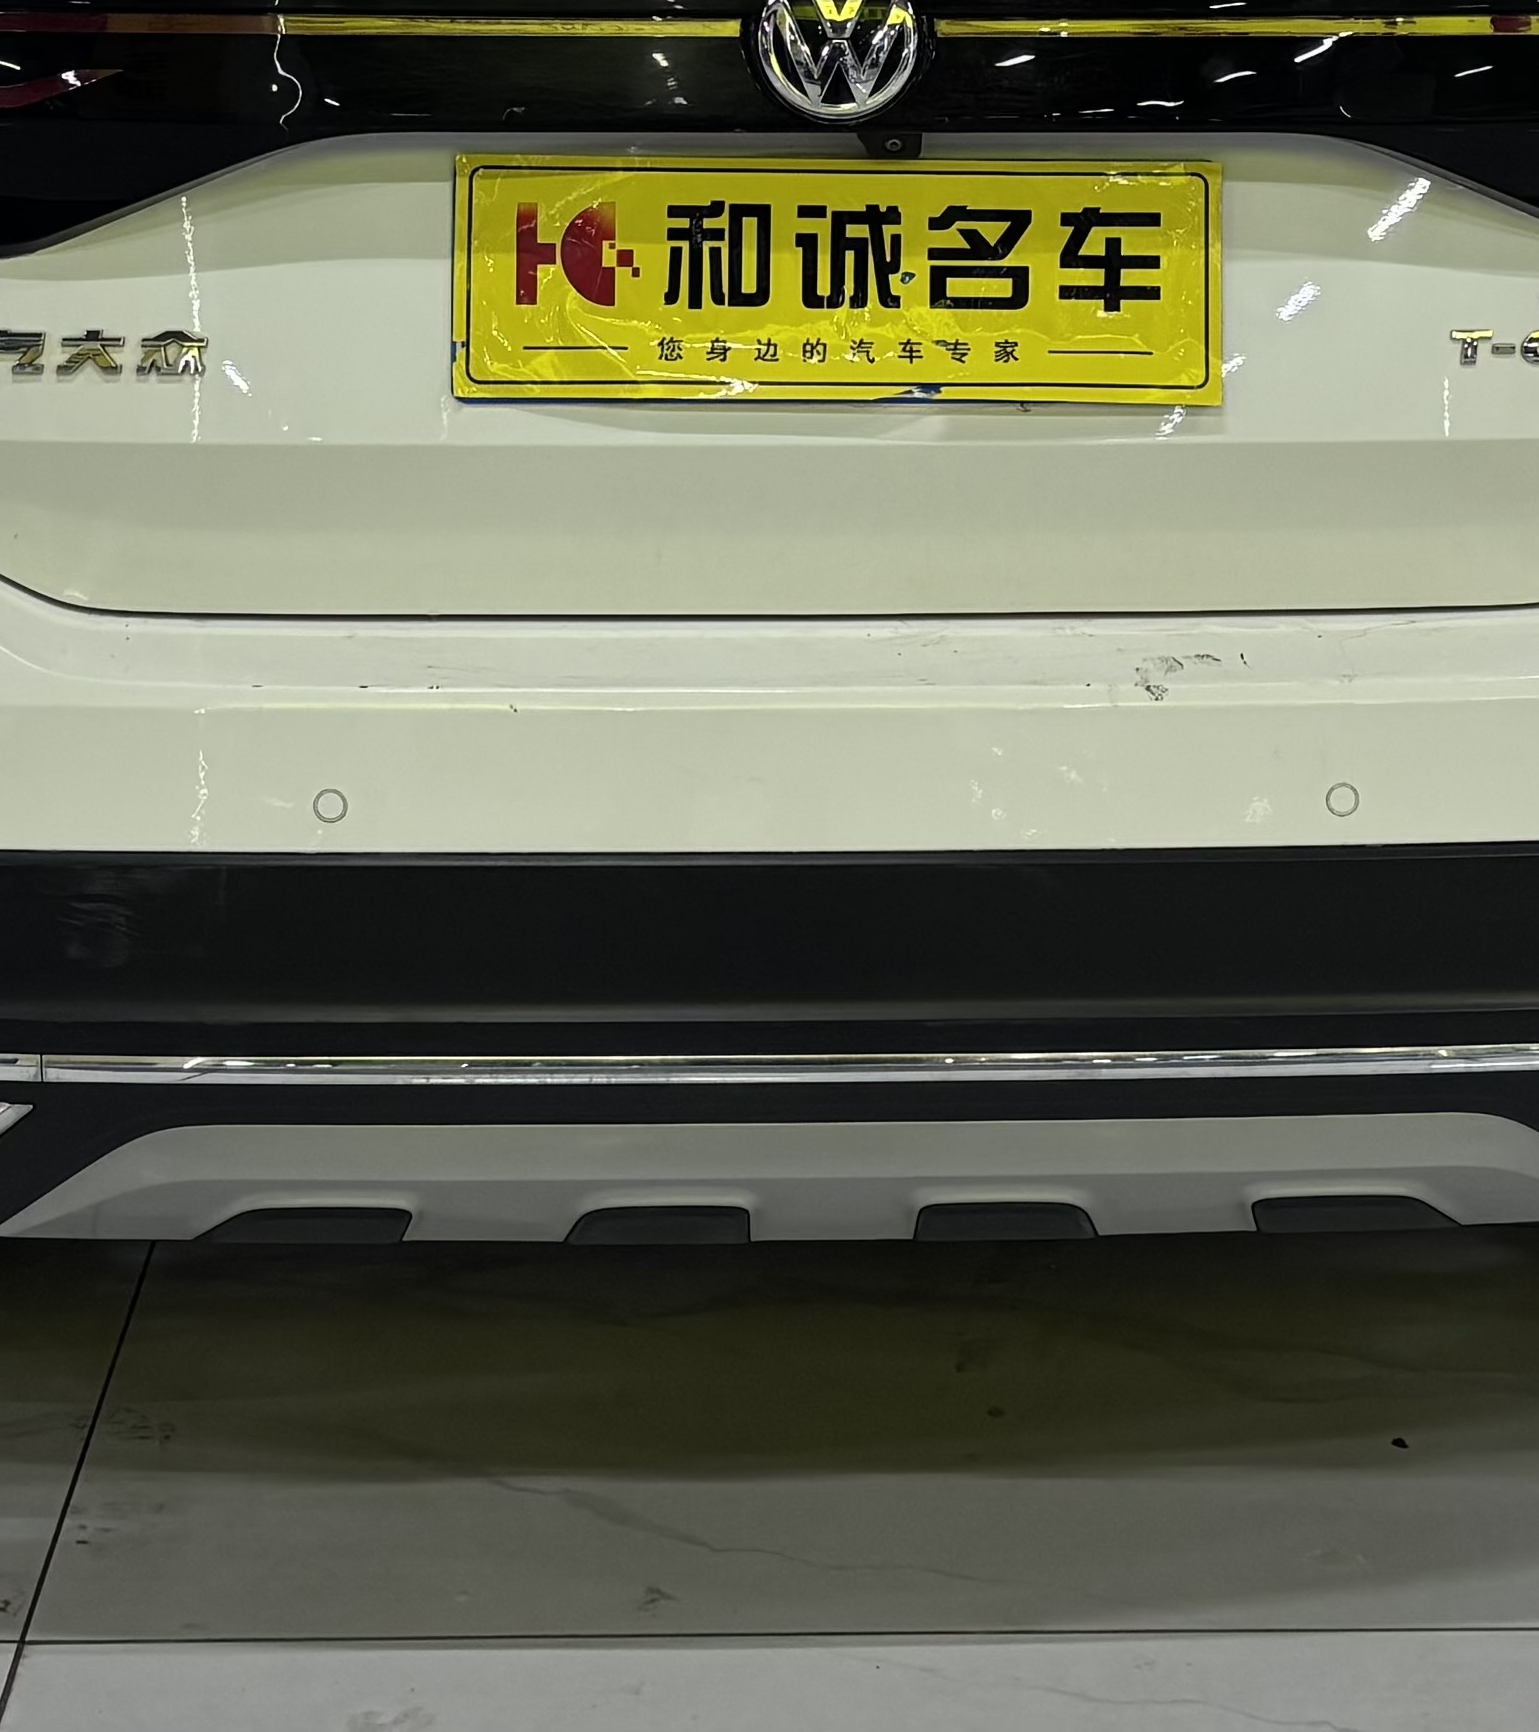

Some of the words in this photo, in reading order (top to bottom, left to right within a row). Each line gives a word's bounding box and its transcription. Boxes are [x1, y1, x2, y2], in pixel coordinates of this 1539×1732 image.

[663, 200, 1164, 313] 和诚名车
[657, 336, 1021, 365] 您身边的汽车专家
